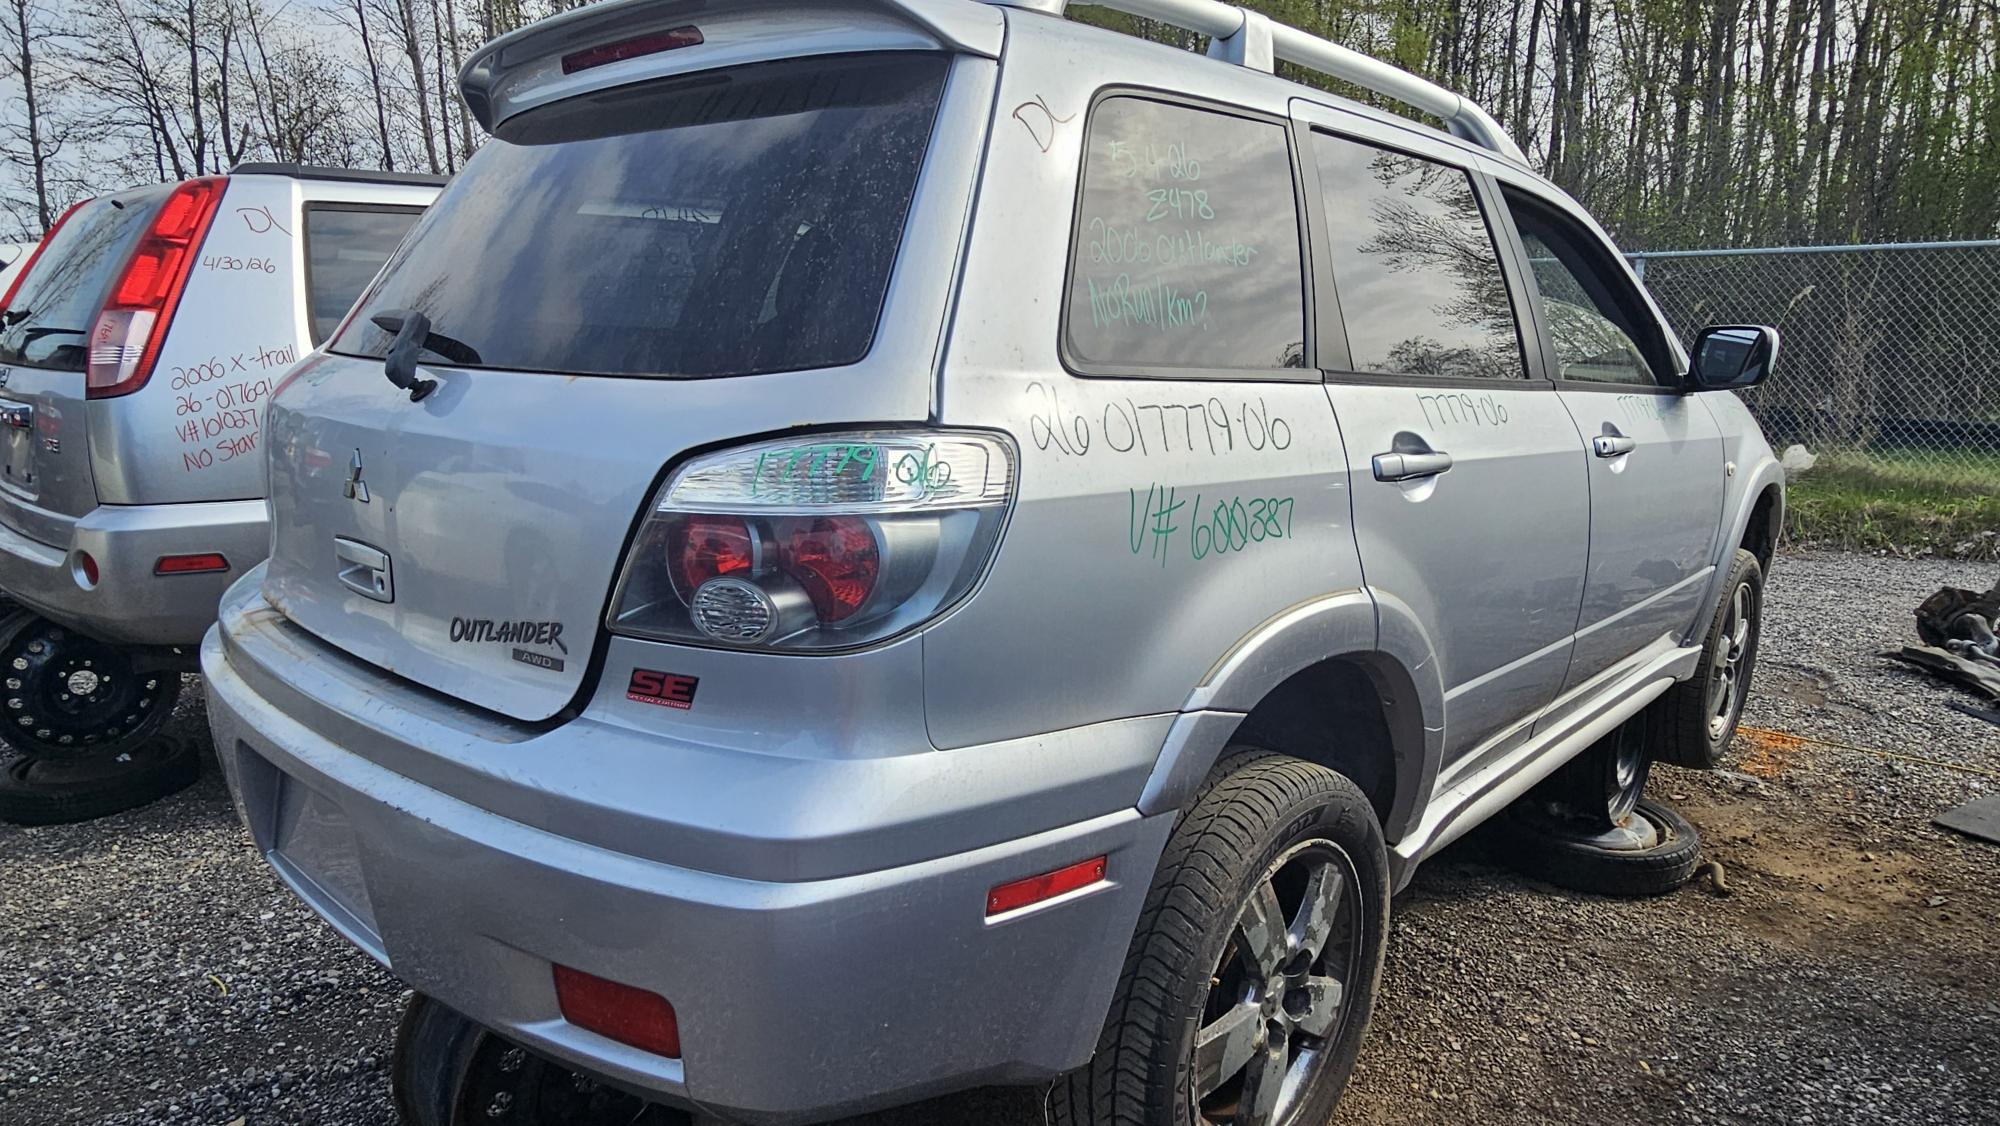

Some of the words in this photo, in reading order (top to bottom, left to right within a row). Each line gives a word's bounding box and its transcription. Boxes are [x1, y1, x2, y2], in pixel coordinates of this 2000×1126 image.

[171, 355, 225, 390] 2006
[216, 431, 259, 462] Star
[449, 616, 569, 655] OUTLANDER
[521, 652, 552, 667] AWD
[630, 670, 695, 701] SE
